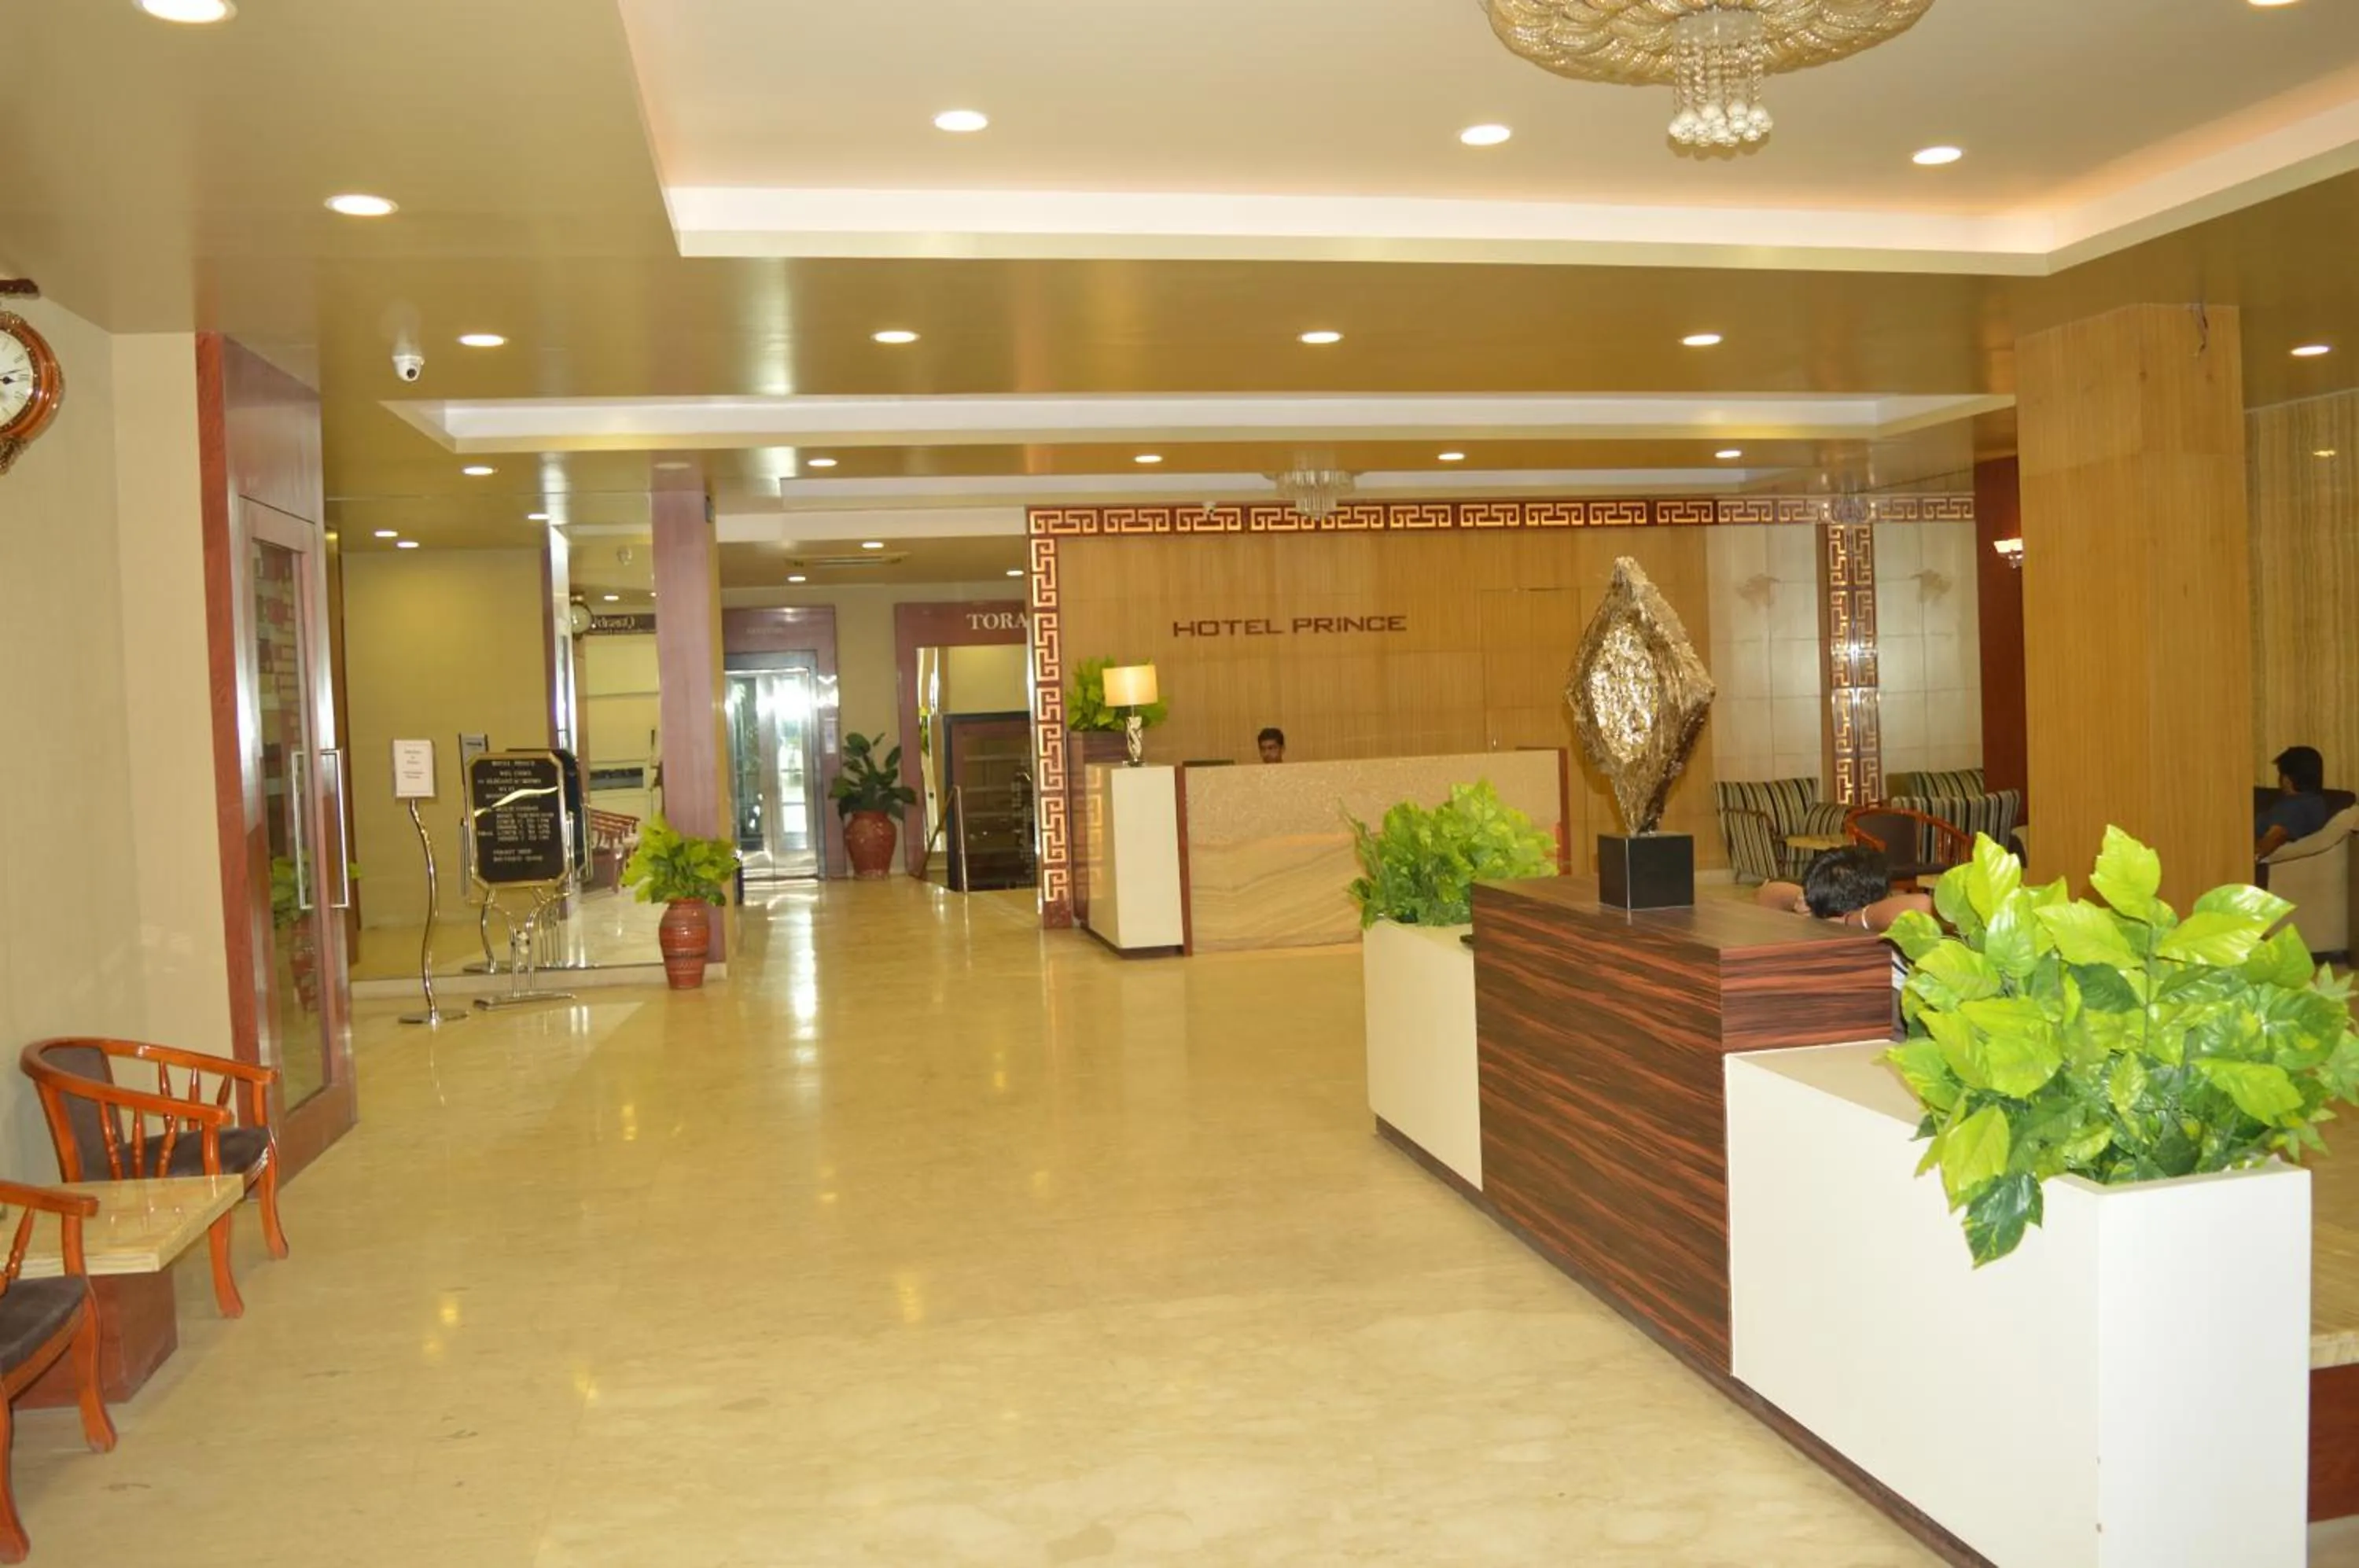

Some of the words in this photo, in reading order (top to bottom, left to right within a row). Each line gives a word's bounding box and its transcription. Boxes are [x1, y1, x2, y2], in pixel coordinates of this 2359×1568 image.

[966, 612, 1027, 630] TORA
[1172, 619, 1283, 638] HOTEL
[1292, 615, 1408, 634] PRINCE
